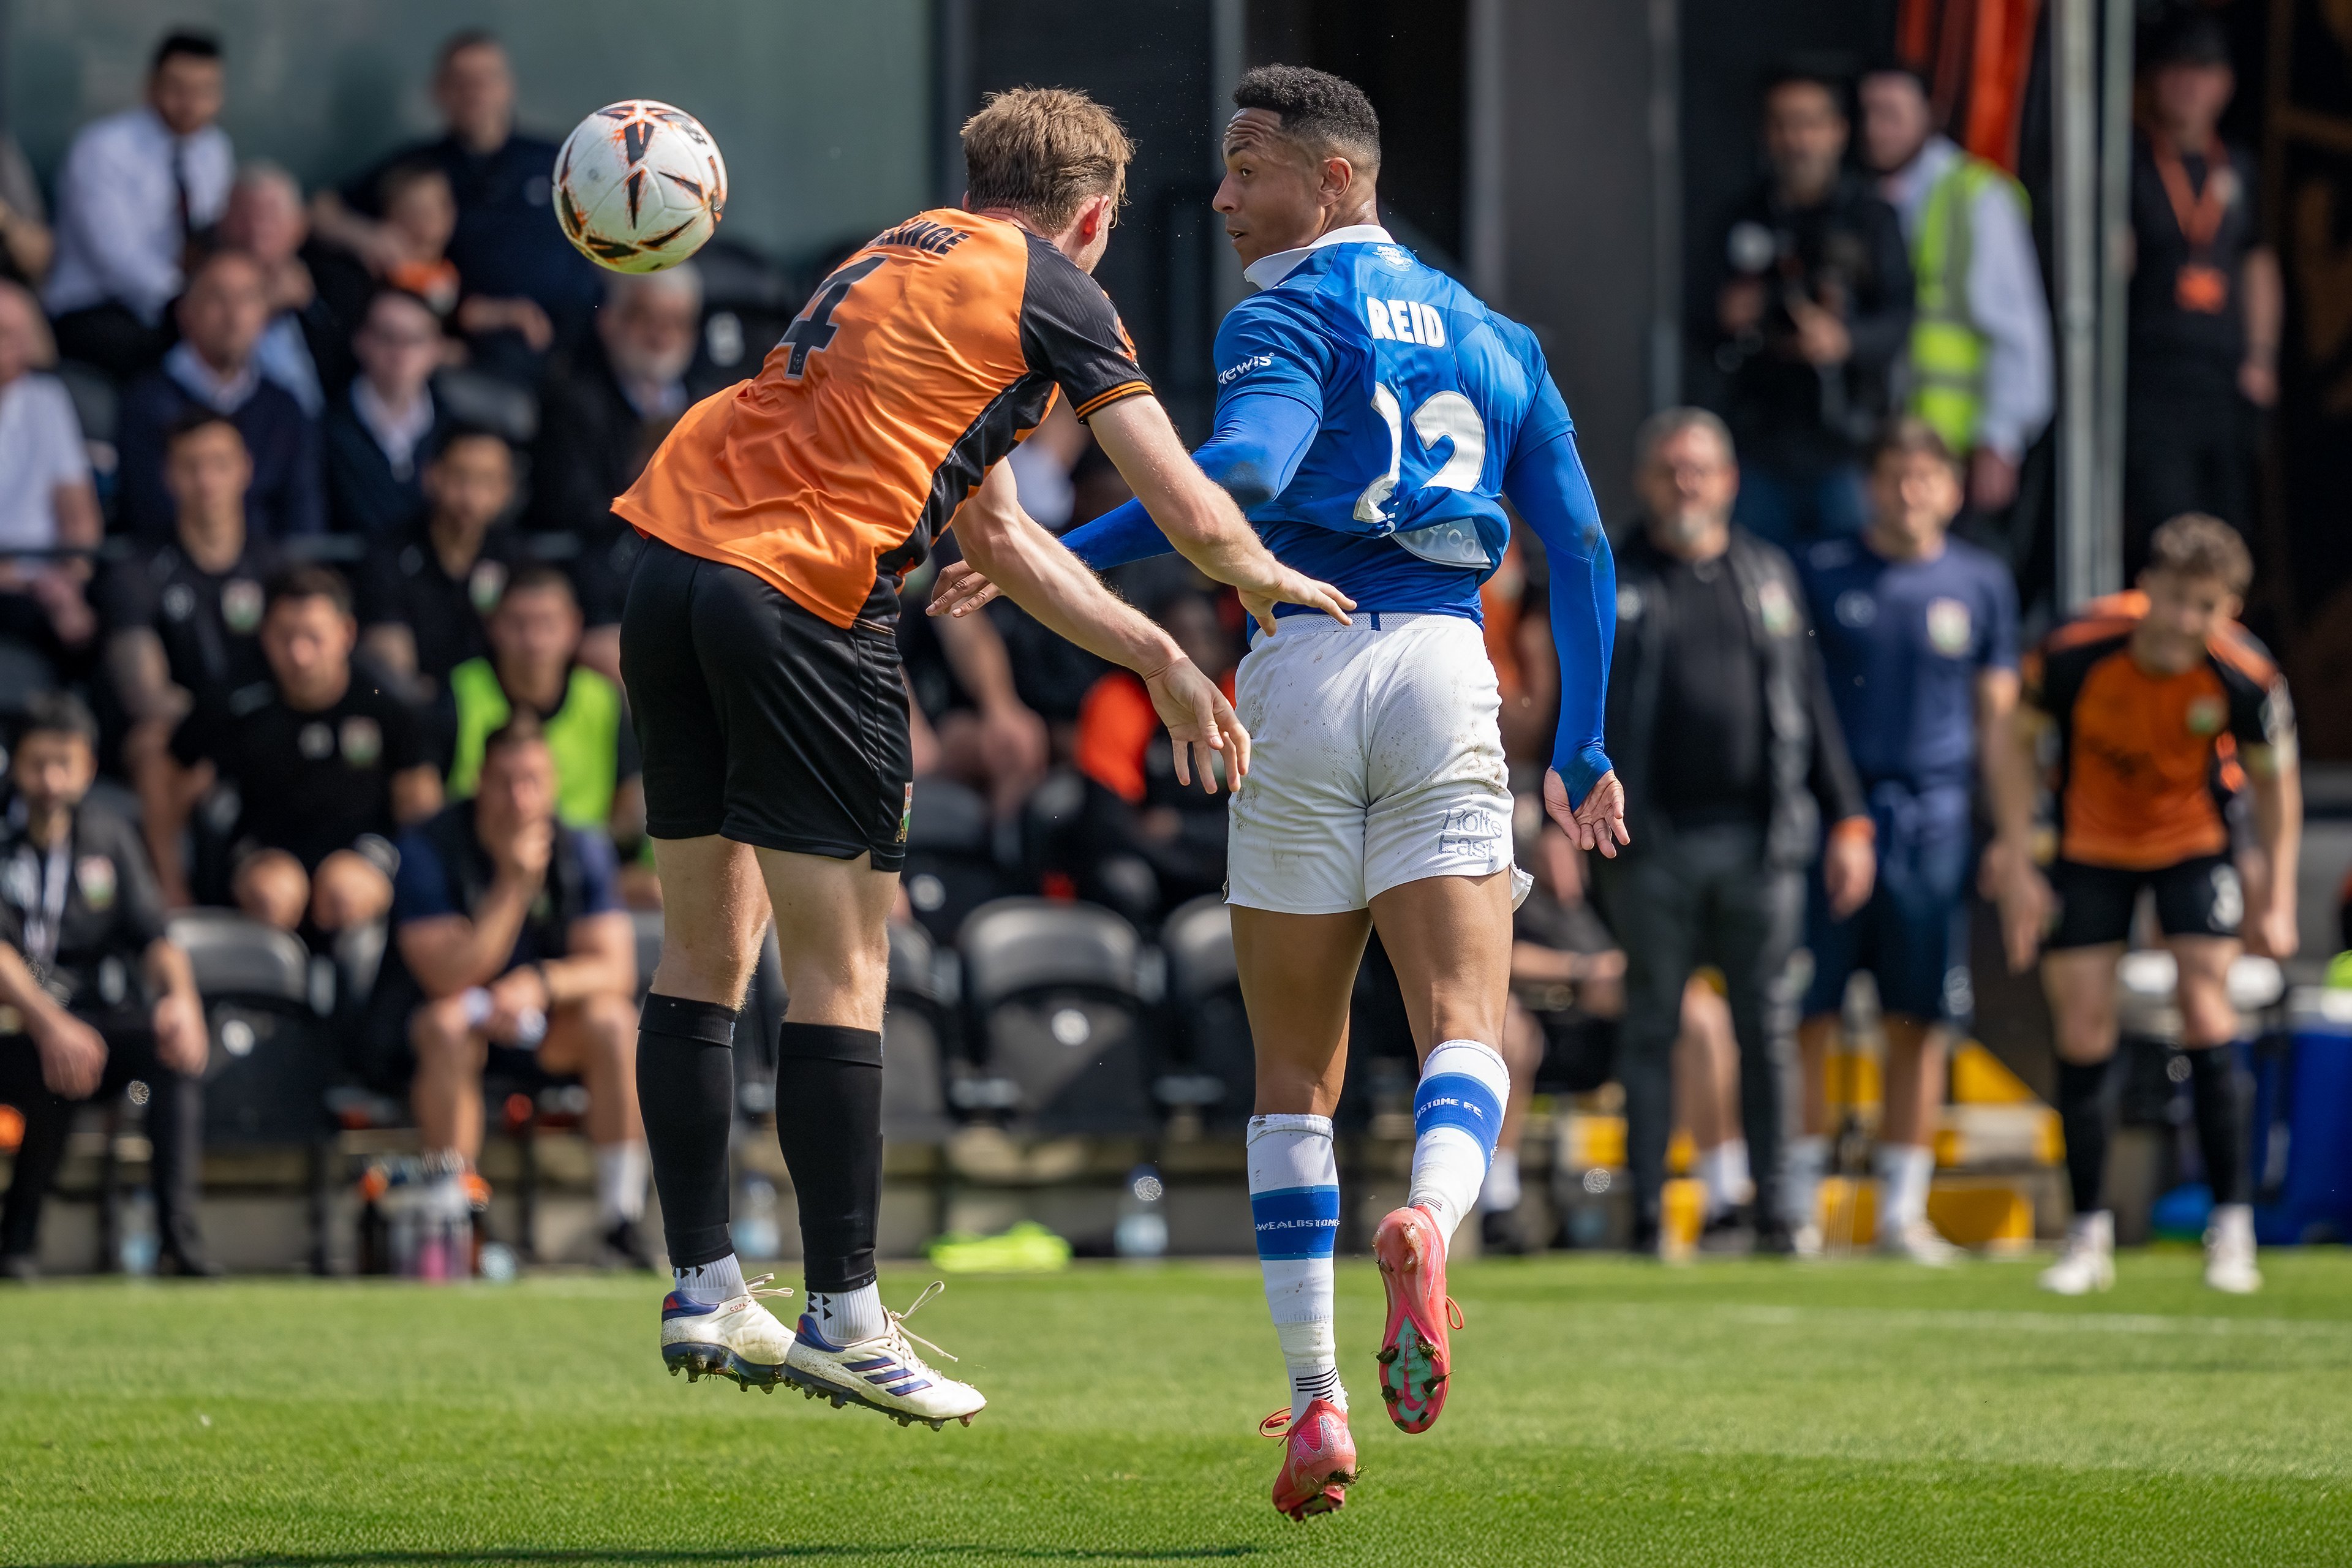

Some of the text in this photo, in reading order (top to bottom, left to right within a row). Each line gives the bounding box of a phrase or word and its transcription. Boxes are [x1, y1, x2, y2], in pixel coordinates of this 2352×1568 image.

[779, 255, 888, 379] 4
[1366, 296, 1446, 347] REID
[1438, 830, 1494, 862] East
